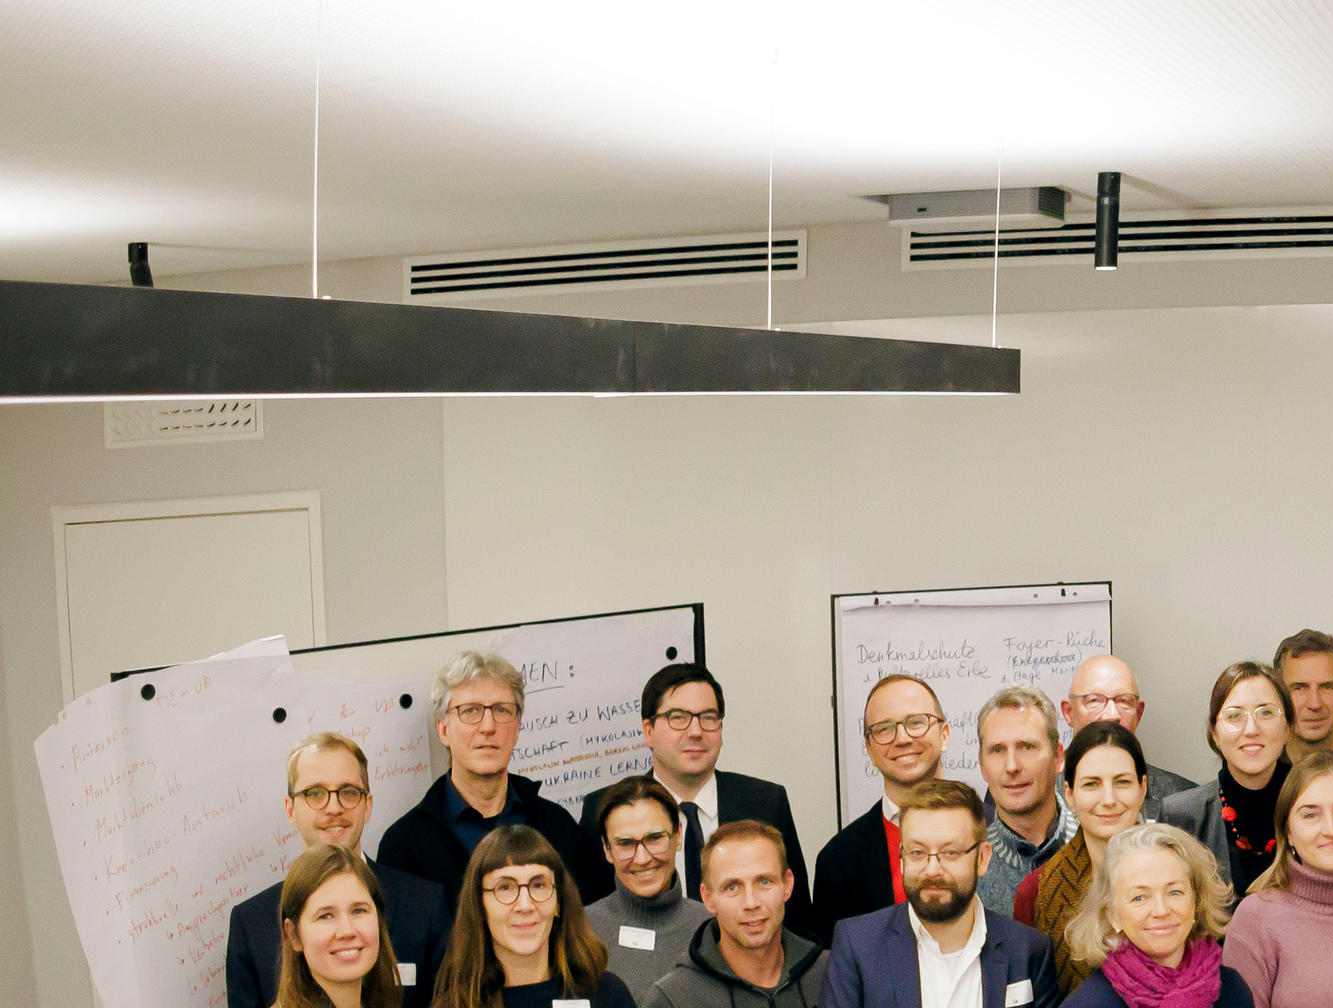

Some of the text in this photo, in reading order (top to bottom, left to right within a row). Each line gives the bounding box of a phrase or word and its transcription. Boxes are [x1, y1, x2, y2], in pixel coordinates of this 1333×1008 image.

[856, 638, 975, 663] Denkmalschutz
[1003, 637, 1055, 661] Foyer
[957, 661, 991, 679] Erbe
[566, 710, 589, 726] ZU
[597, 698, 642, 723] WASSE
[543, 766, 602, 788] UKRAINE
